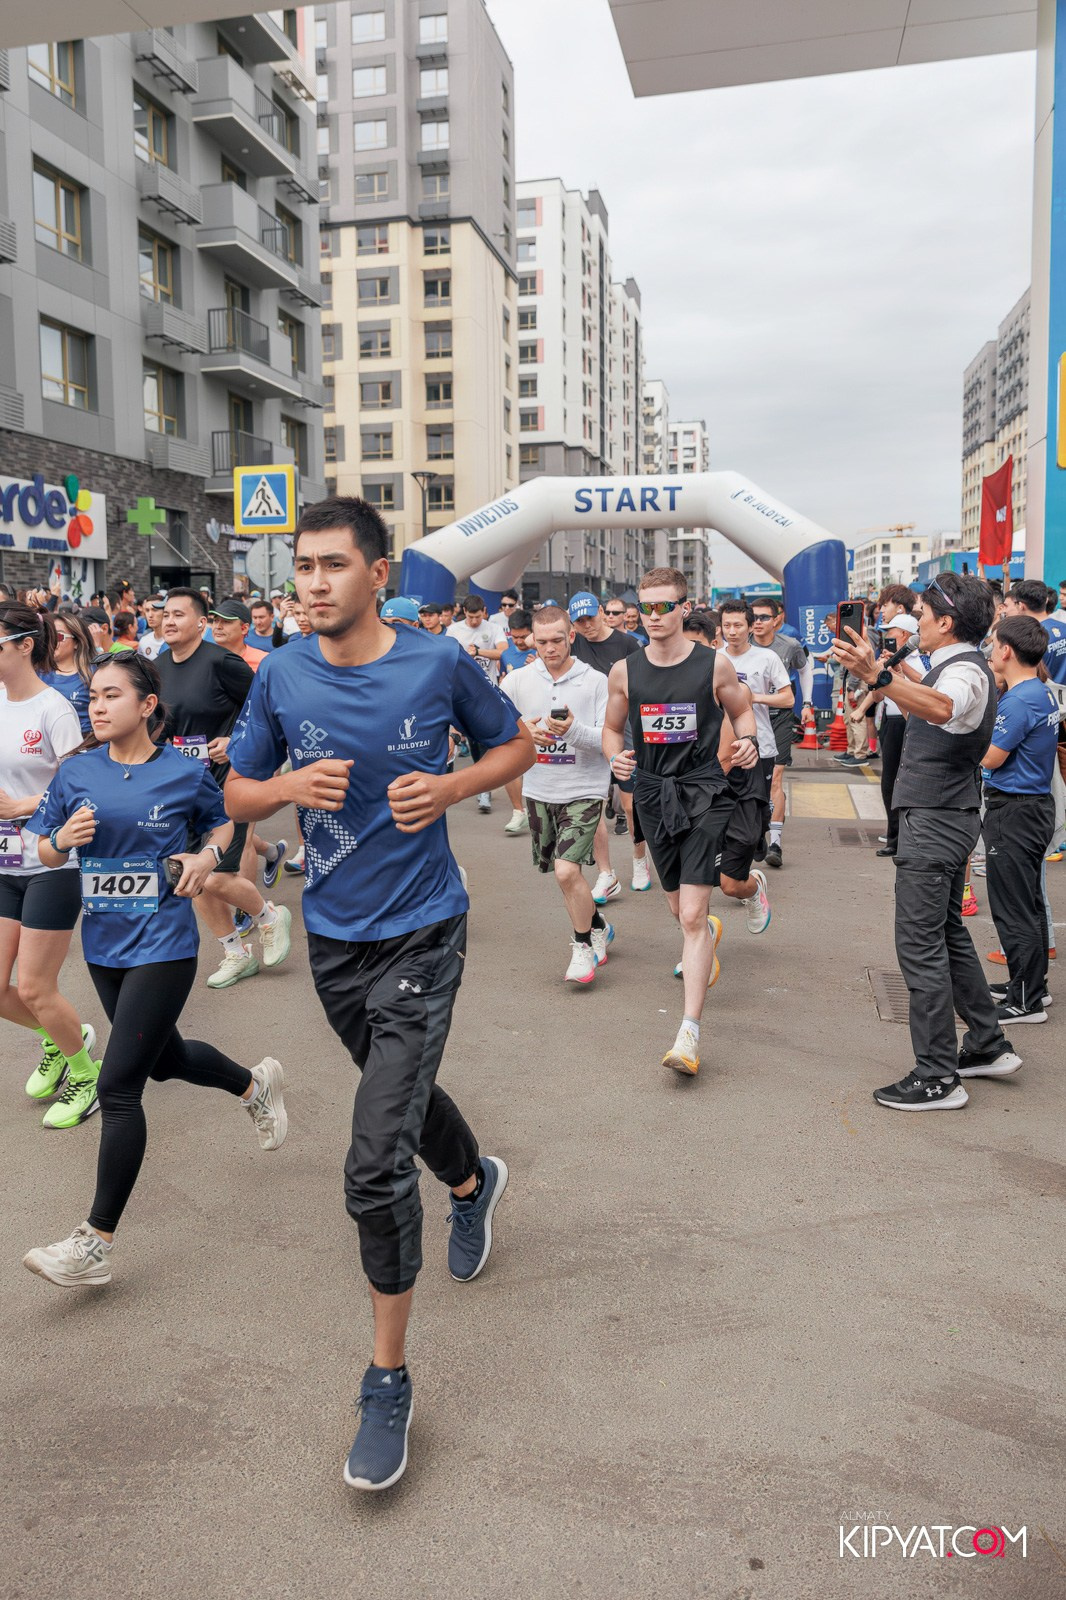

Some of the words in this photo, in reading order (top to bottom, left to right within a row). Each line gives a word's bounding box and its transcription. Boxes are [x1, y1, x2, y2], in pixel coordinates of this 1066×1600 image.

[0, 473, 68, 530] rde
[574, 486, 683, 513] START
[456, 498, 519, 537] INVICTUS
[571, 598, 592, 612] FRANCE
[805, 608, 816, 646] Arena
[651, 716, 687, 731] 453
[177, 746, 200, 758] 60
[387, 744, 395, 752] BI
[396, 739, 430, 751] JULDYZAI
[303, 750, 334, 759] GROUP
[85, 860, 92, 868] 5
[92, 875, 152, 895] 1407
